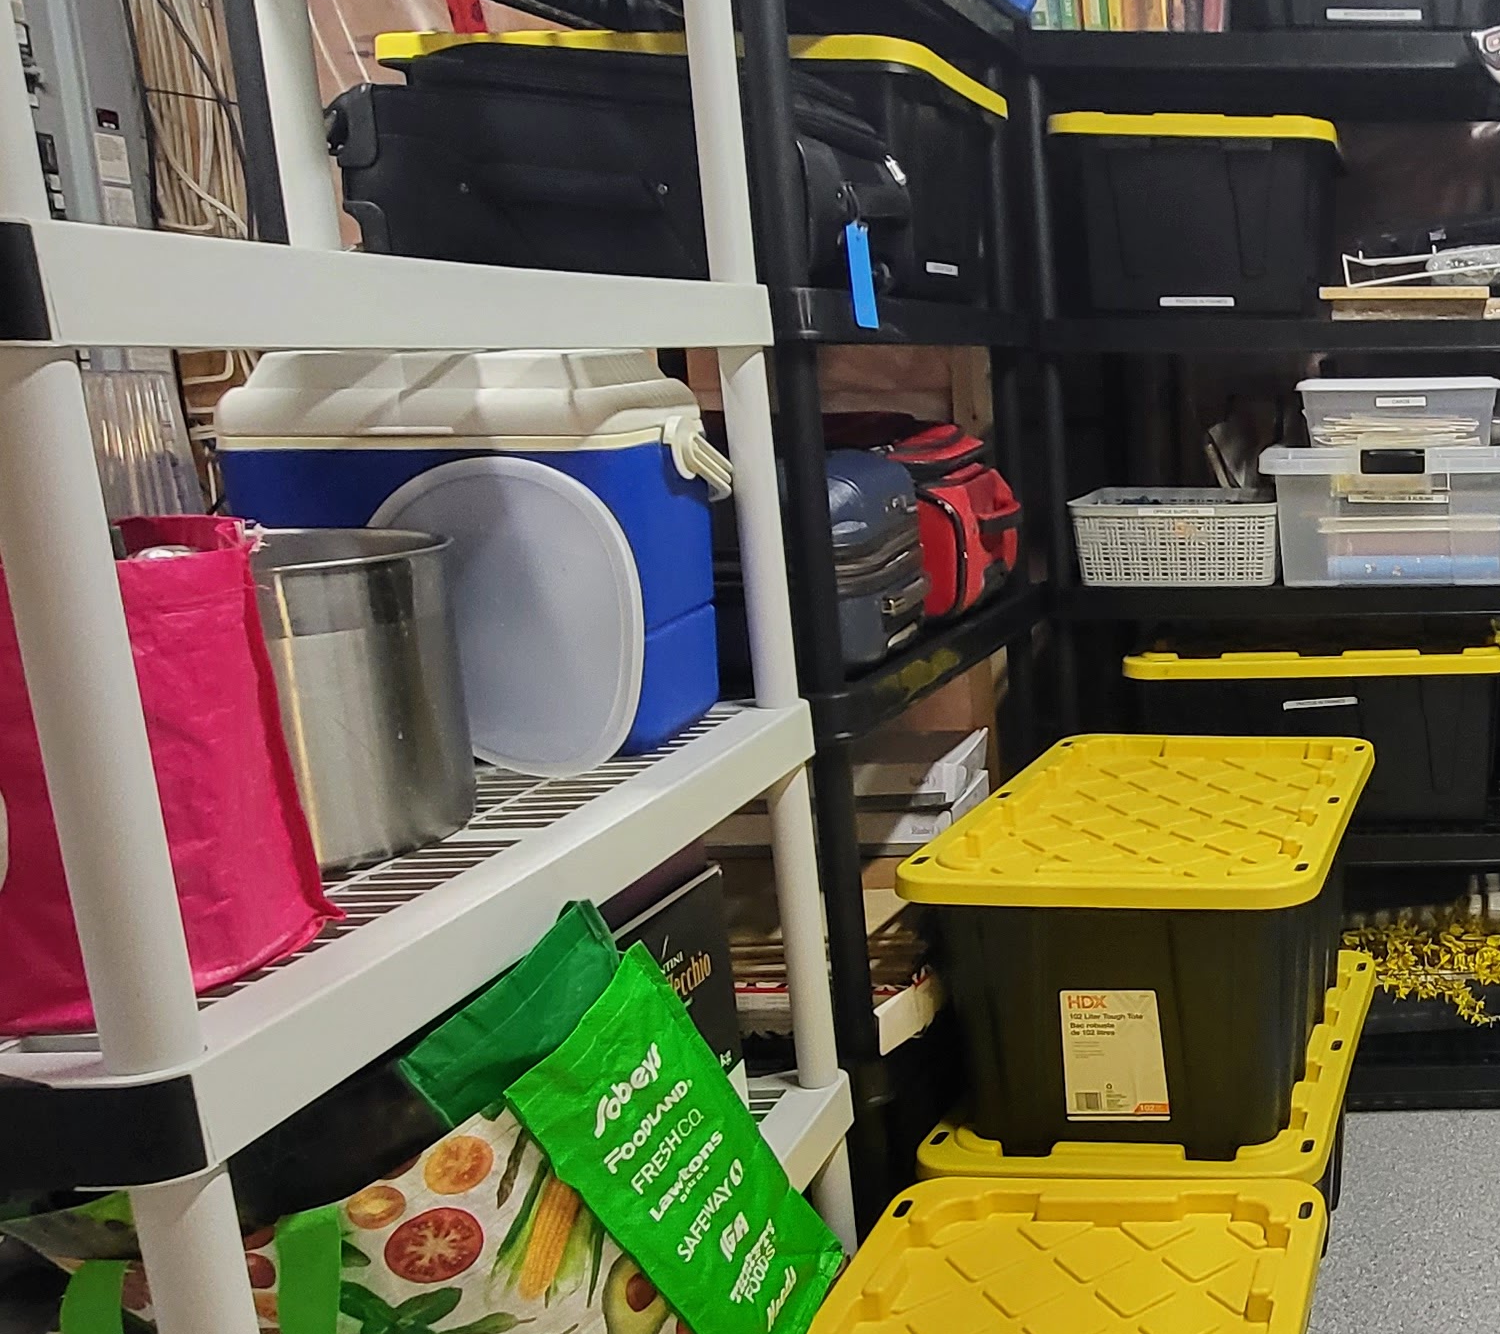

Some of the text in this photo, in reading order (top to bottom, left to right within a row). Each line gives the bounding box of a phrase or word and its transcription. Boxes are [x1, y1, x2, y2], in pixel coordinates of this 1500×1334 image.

[1067, 994, 1107, 1009] HDX
[594, 1042, 662, 1139] Sobeys
[648, 1130, 724, 1223] Lawtons
[676, 1176, 733, 1263] SAFEWAY
[719, 1211, 750, 1263] IGA
[743, 1243, 777, 1304] FOODS
